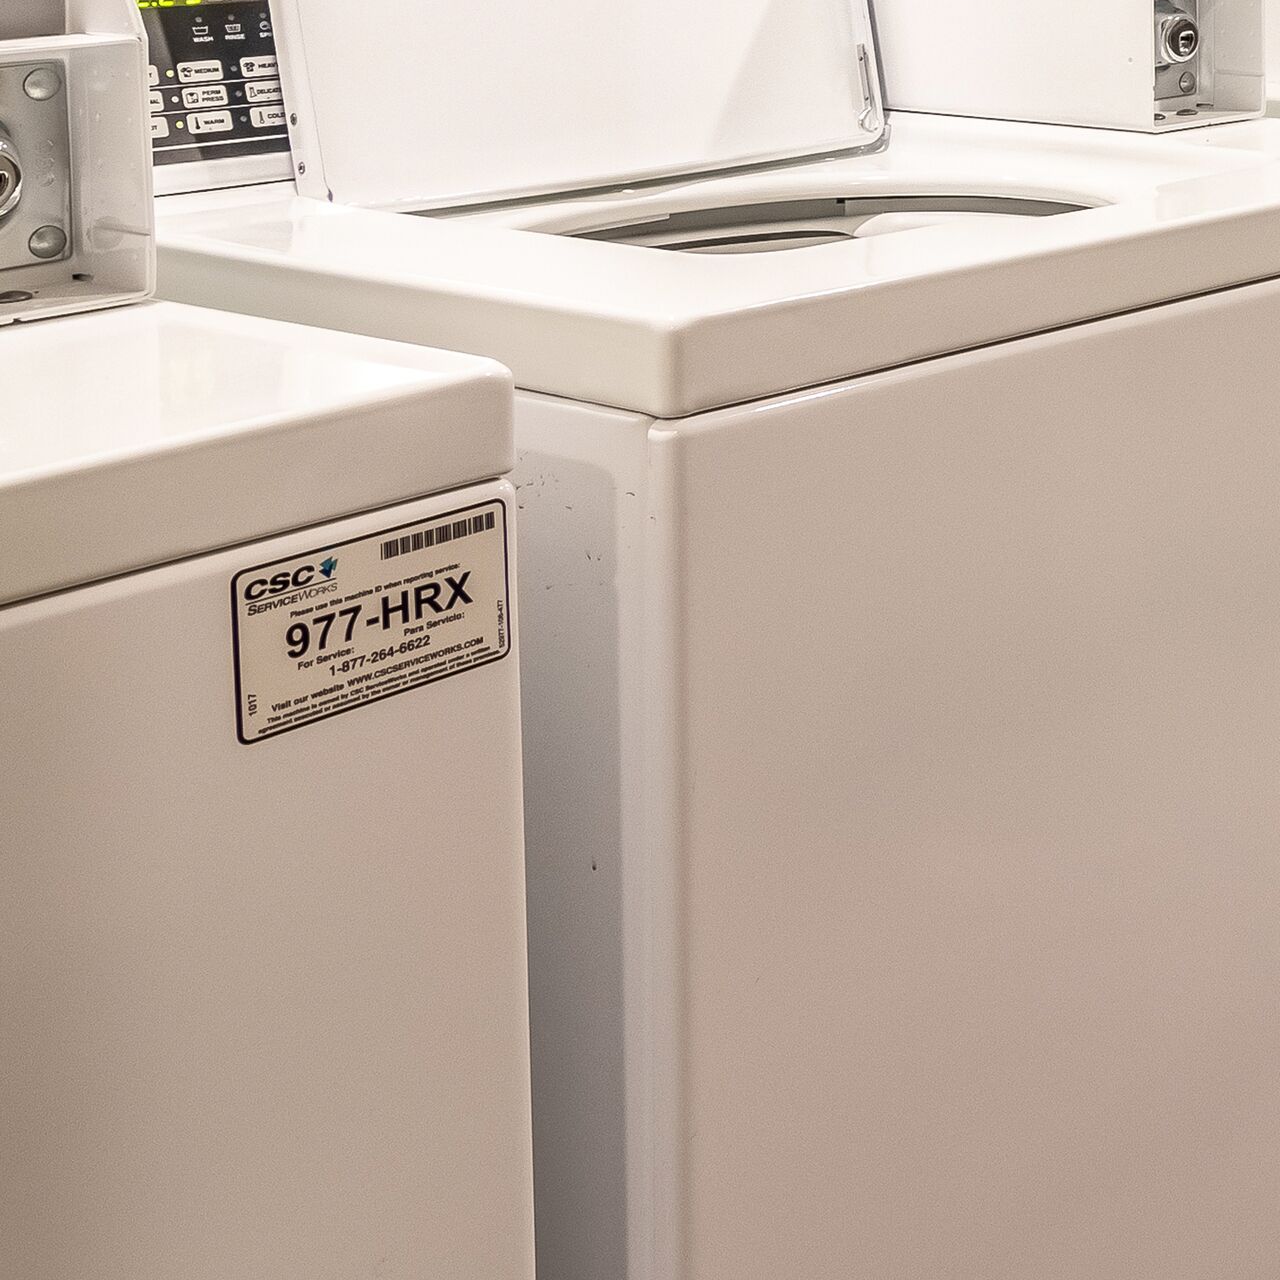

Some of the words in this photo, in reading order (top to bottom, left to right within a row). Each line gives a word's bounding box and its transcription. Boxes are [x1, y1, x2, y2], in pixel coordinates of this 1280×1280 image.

[194, 66, 220, 75] MEDIUM
[201, 95, 225, 103] PRESS
[244, 564, 316, 601] CSC
[290, 605, 314, 619] Please
[314, 602, 329, 612] use
[329, 597, 343, 607] this
[344, 588, 374, 603] machine
[374, 585, 383, 593] ID
[383, 580, 403, 591] when
[403, 570, 434, 586] reporting
[434, 563, 461, 576] service:
[286, 571, 473, 659] 977-HRX
[404, 624, 424, 637] Para
[426, 612, 465, 630] Servicio:
[297, 659, 314, 671] For
[316, 646, 355, 665] Service:
[329, 634, 431, 676] 1-877-264-6622
[271, 700, 292, 713] Visit
[294, 694, 309, 705] our
[310, 683, 345, 700] website
[346, 636, 485, 687] WWW.CSCSERVICEWORKS.COM
[247, 694, 257, 717] 1017
